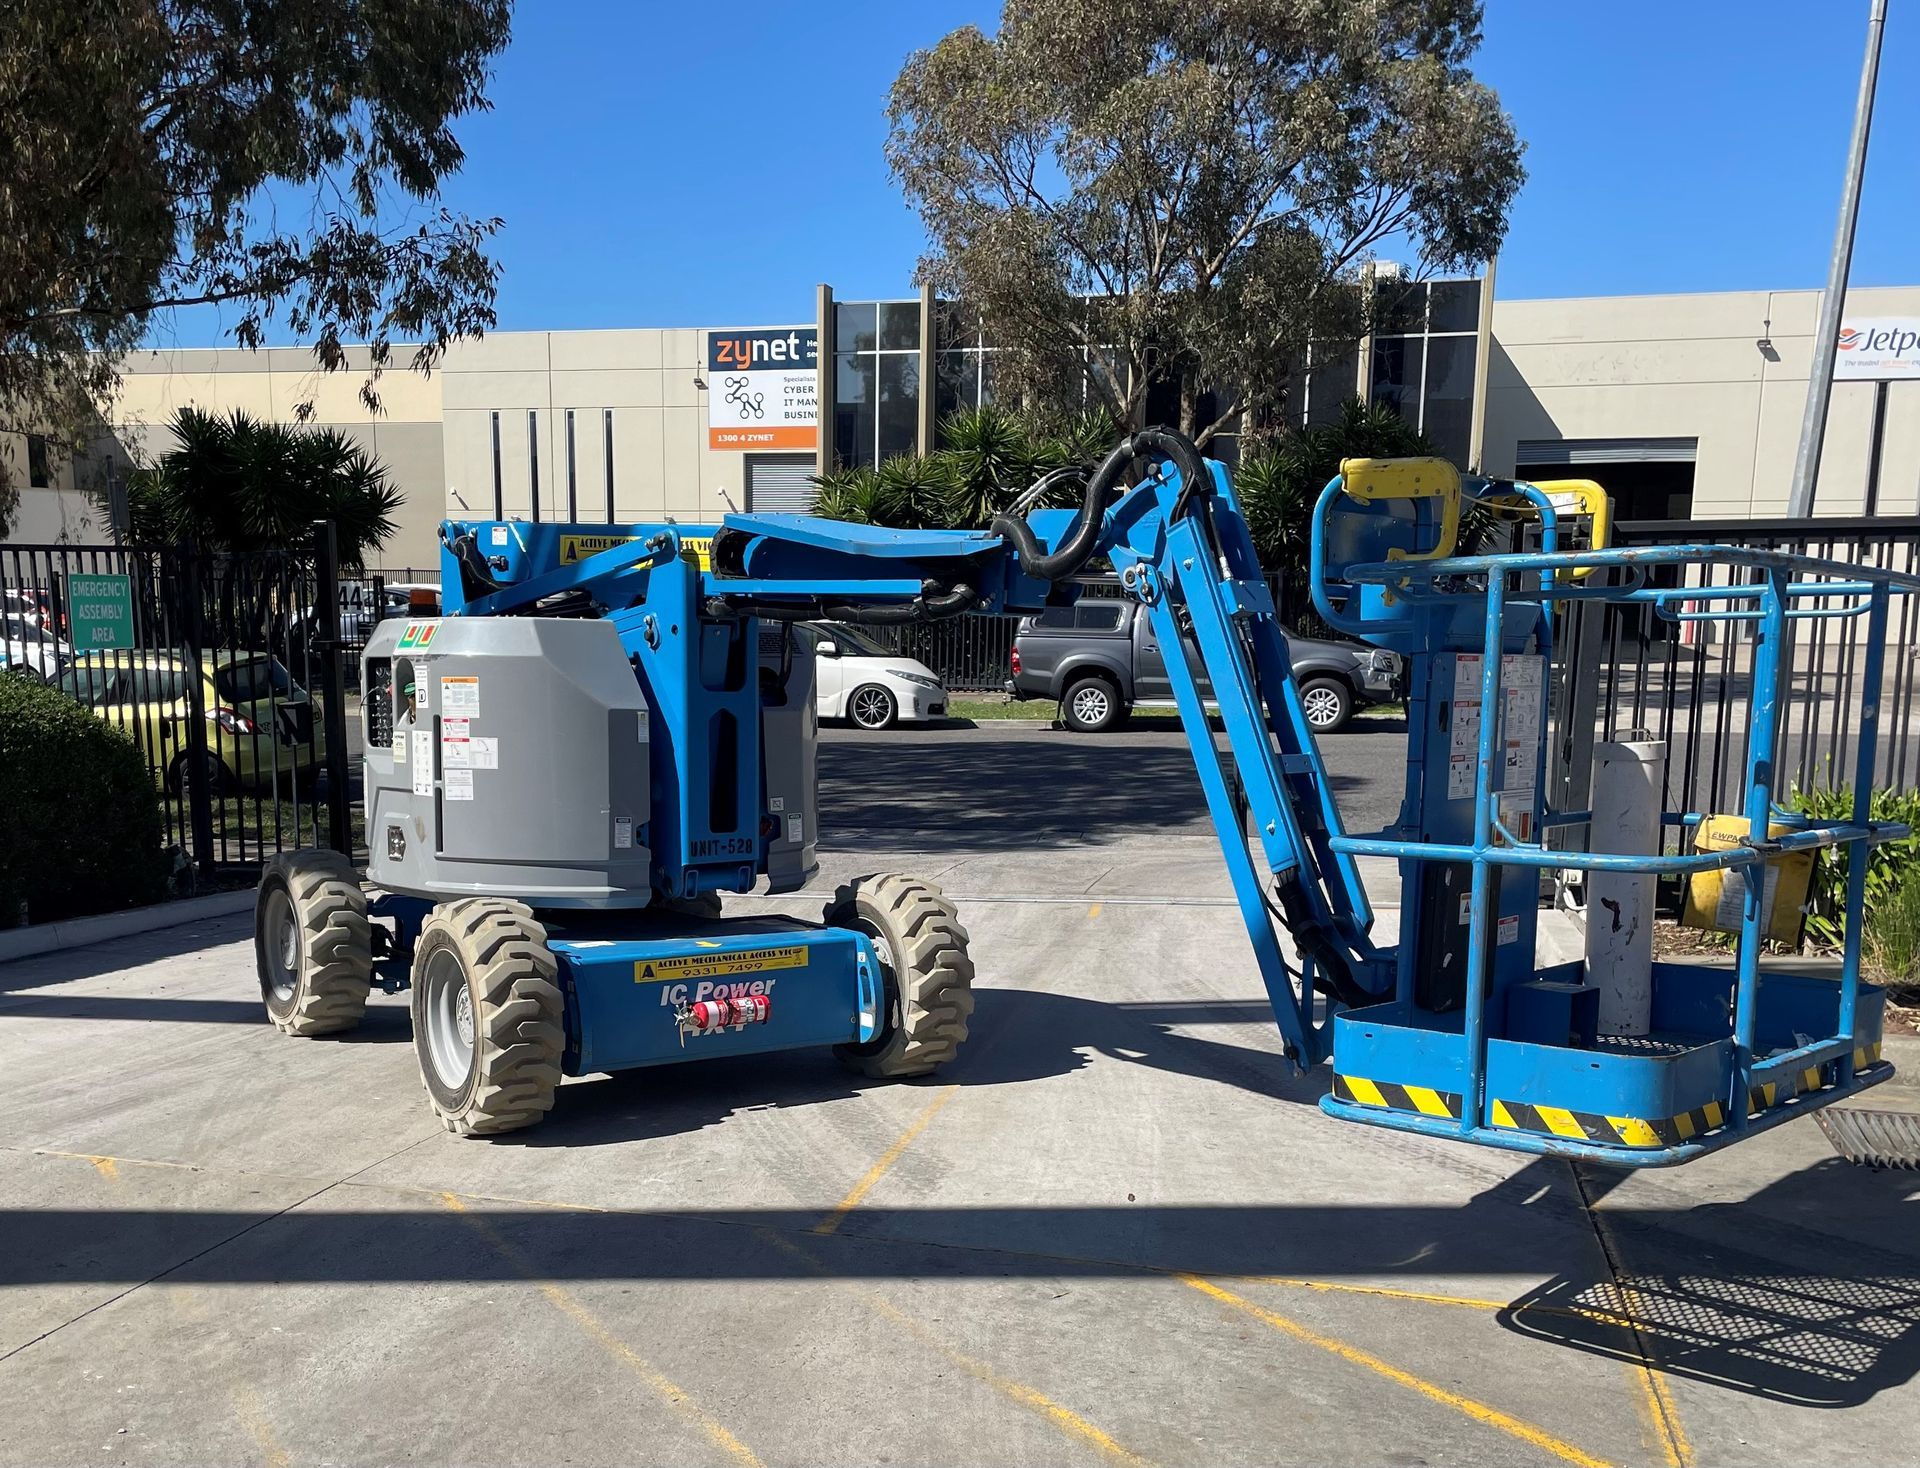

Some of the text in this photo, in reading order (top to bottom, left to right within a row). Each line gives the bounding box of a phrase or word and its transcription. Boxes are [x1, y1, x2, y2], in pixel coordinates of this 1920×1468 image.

[716, 331, 800, 370] zynet
[784, 386, 815, 394] CYBER
[718, 434, 738, 442] 1300
[747, 434, 775, 442] ZYNET
[580, 538, 608, 548] ACTIVE
[72, 582, 127, 597] EMERGENCY
[79, 604, 124, 620] ASSEMBLY
[92, 627, 116, 642] AREA
[690, 838, 753, 857] UNIT-528
[658, 959, 689, 969] ACTIVE
[691, 953, 747, 966] MECHANICAL
[749, 950, 776, 960] ACCESS
[778, 949, 793, 957] VIC
[682, 966, 718, 977] 9331
[728, 962, 763, 973] 7499
[660, 979, 776, 1006] IC Power
